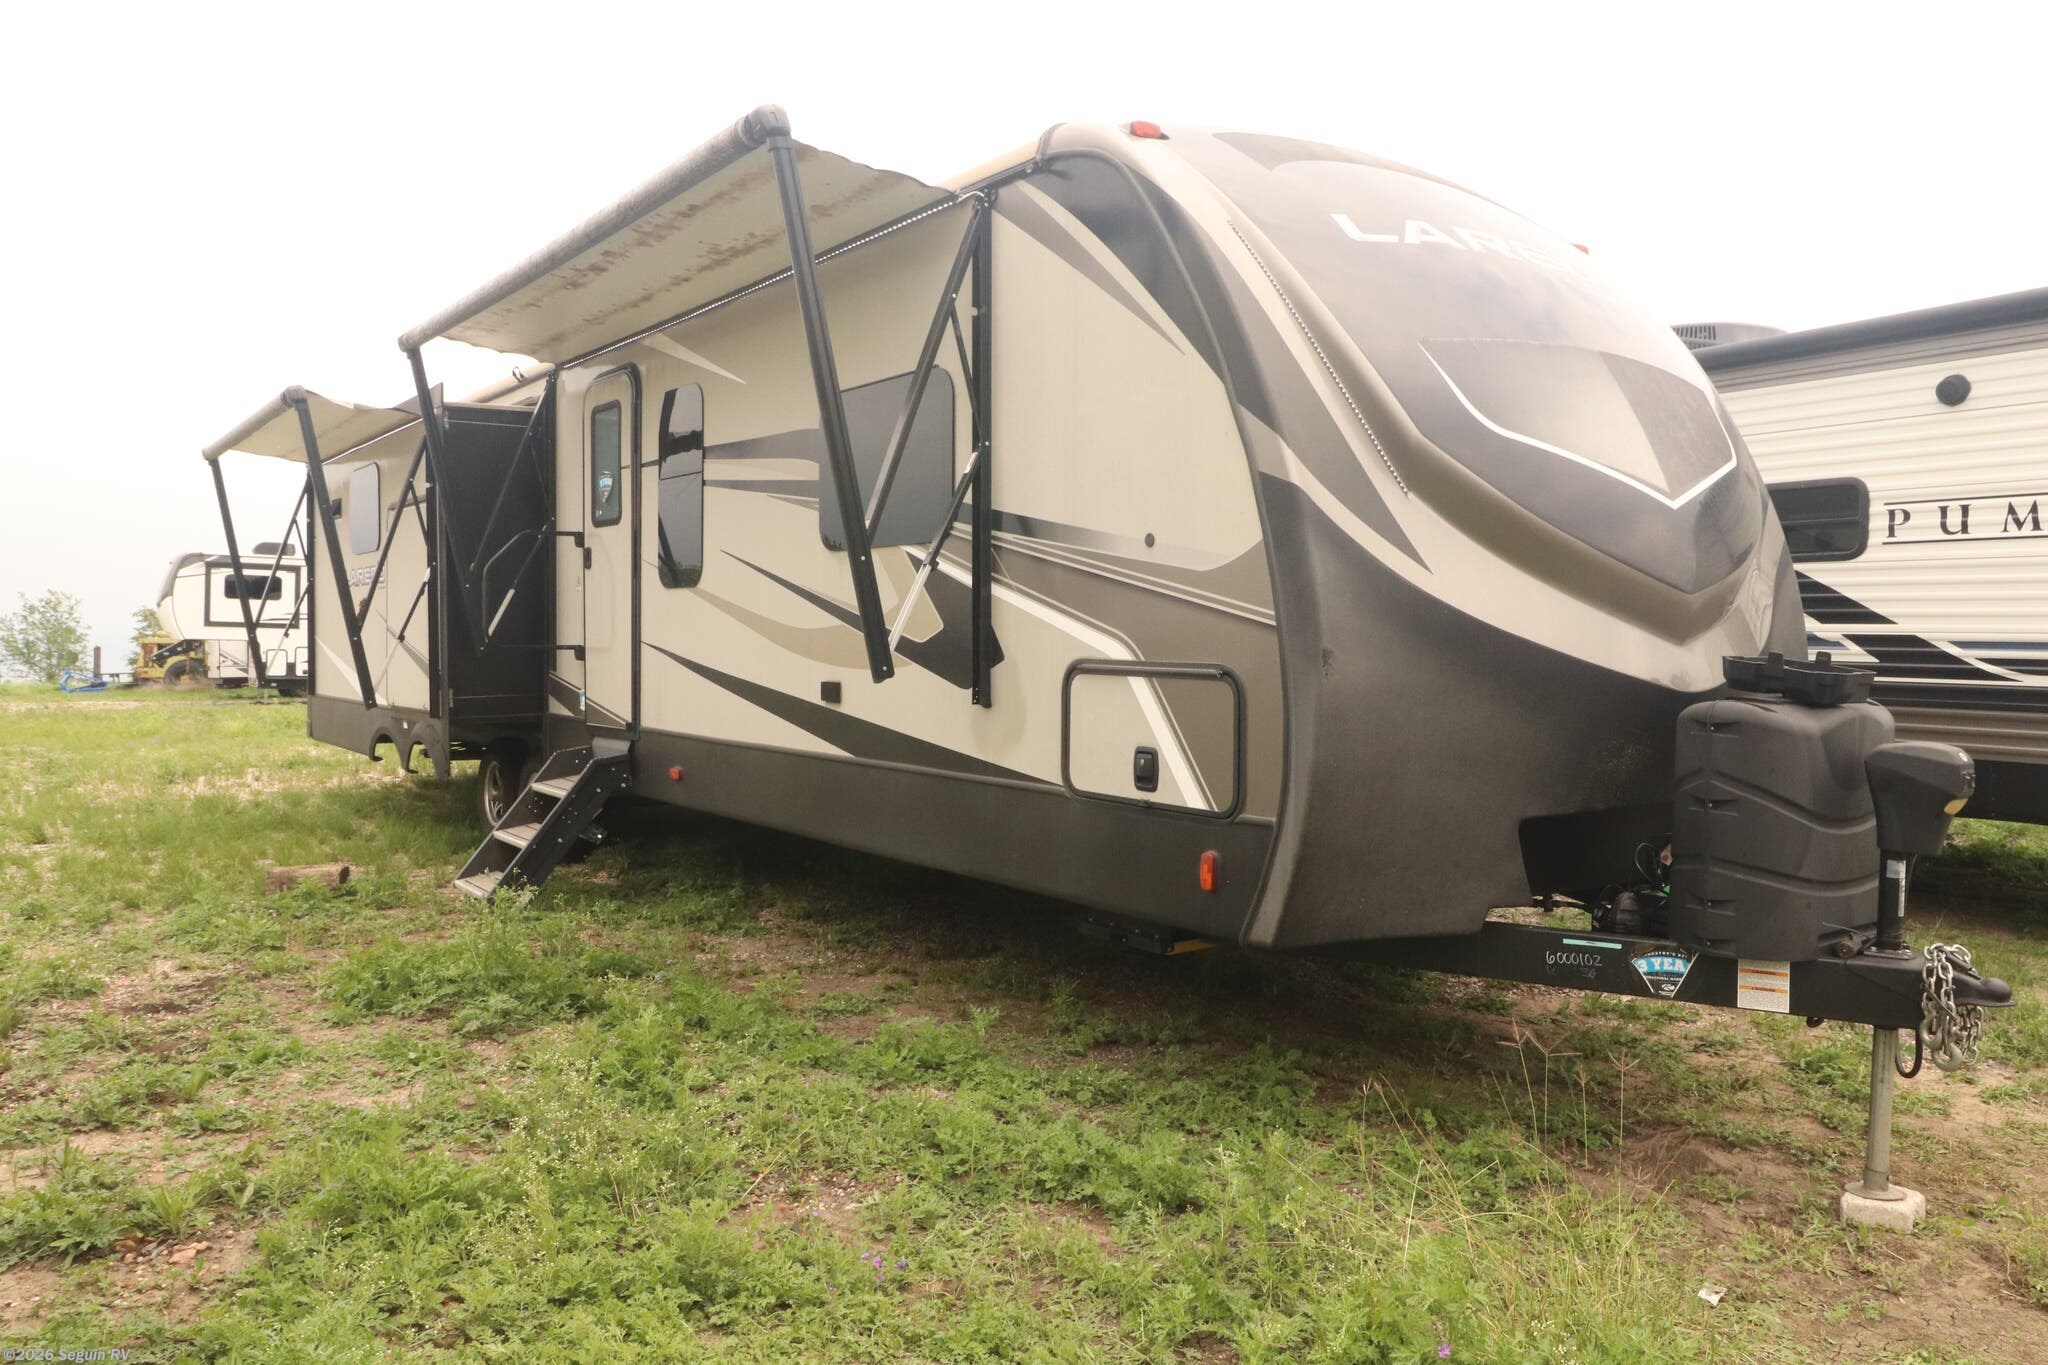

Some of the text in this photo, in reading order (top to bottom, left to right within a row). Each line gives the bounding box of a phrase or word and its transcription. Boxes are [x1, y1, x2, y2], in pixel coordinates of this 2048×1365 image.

[1886, 500, 2044, 538] PUM
[1545, 950, 1603, 967] 6000102
[1638, 959, 1648, 972] 3
